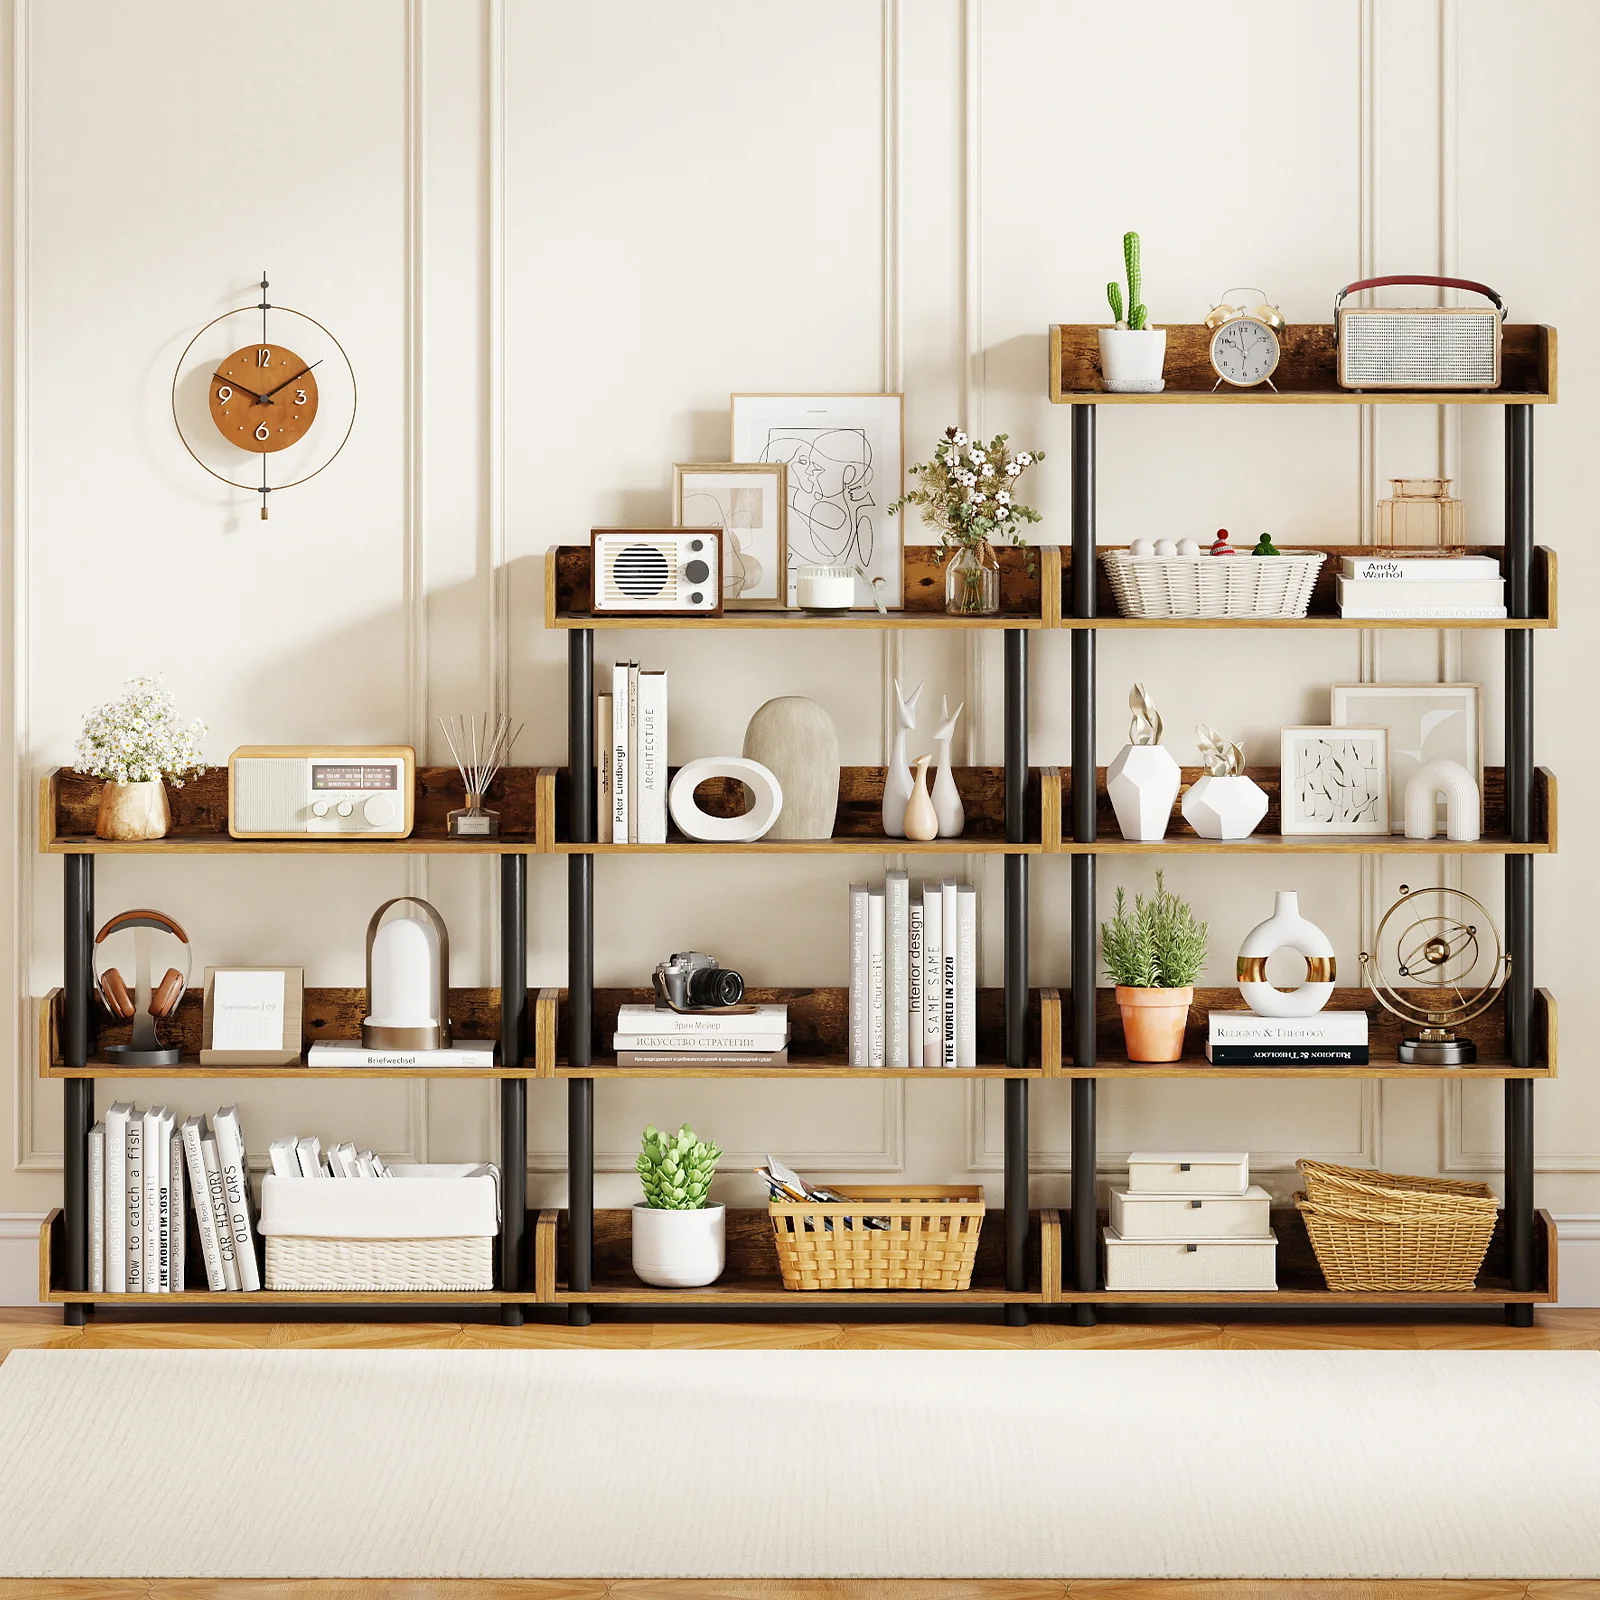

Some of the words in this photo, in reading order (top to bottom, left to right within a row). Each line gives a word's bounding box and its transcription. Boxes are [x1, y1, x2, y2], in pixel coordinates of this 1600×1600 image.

[258, 349, 271, 367] 12
[218, 386, 233, 405] 9
[294, 390, 307, 405] 3
[255, 421, 270, 441] 6
[1368, 563, 1398, 572] Andy
[645, 708, 654, 791] ARCHITECTURE
[615, 745, 625, 795] Lindbergh
[615, 798, 624, 823] Peter
[854, 896, 862, 919] Voice
[893, 883, 901, 907] house
[893, 911, 901, 925] the
[893, 929, 901, 938] in
[909, 911, 923, 959] design
[961, 916, 971, 976] DECORATES
[854, 931, 864, 963] Hawking
[894, 943, 902, 992] arrangement
[928, 946, 940, 985] SAME
[945, 956, 954, 985] 2020
[854, 967, 863, 998] Stephen
[873, 952, 882, 1009] Churchill
[909, 963, 921, 1013] Interior
[945, 988, 954, 999] IN
[854, 1001, 862, 1020] Gave
[895, 997, 901, 1007] an
[928, 994, 940, 1034] SAME
[961, 981, 971, 1041] HOUSEHOLD
[674, 1021, 694, 1030] Эрин
[695, 1021, 721, 1030] Мейер
[893, 1010, 901, 1029] make
[945, 1002, 954, 1041] WORLD
[636, 1038, 695, 1047] ИСКУССТВО
[698, 1038, 754, 1047] СТРАТЕГИИ
[854, 1024, 862, 1046] Intel
[873, 1015, 882, 1061] Winston
[893, 1033, 901, 1043] to
[1263, 1029, 1273, 1037] &
[367, 1057, 416, 1065] Briefwechsel
[854, 1050, 862, 1064] How
[893, 1047, 901, 1062] How
[945, 1043, 954, 1064] THE
[128, 1129, 140, 1160] fish
[188, 1130, 201, 1174] children
[111, 1138, 121, 1197] DECORATES
[224, 1165, 241, 1204] CARS
[128, 1186, 140, 1227] catch
[147, 1174, 155, 1232] Churchill
[208, 1170, 229, 1228] HISTORY
[111, 1205, 121, 1265] HOUSEHOLD
[173, 1222, 181, 1232] by
[233, 1214, 248, 1243] OLD
[129, 1236, 140, 1251] to
[223, 1236, 234, 1262] CAR
[128, 1259, 140, 1285] How
[147, 1239, 155, 1285] Winston
